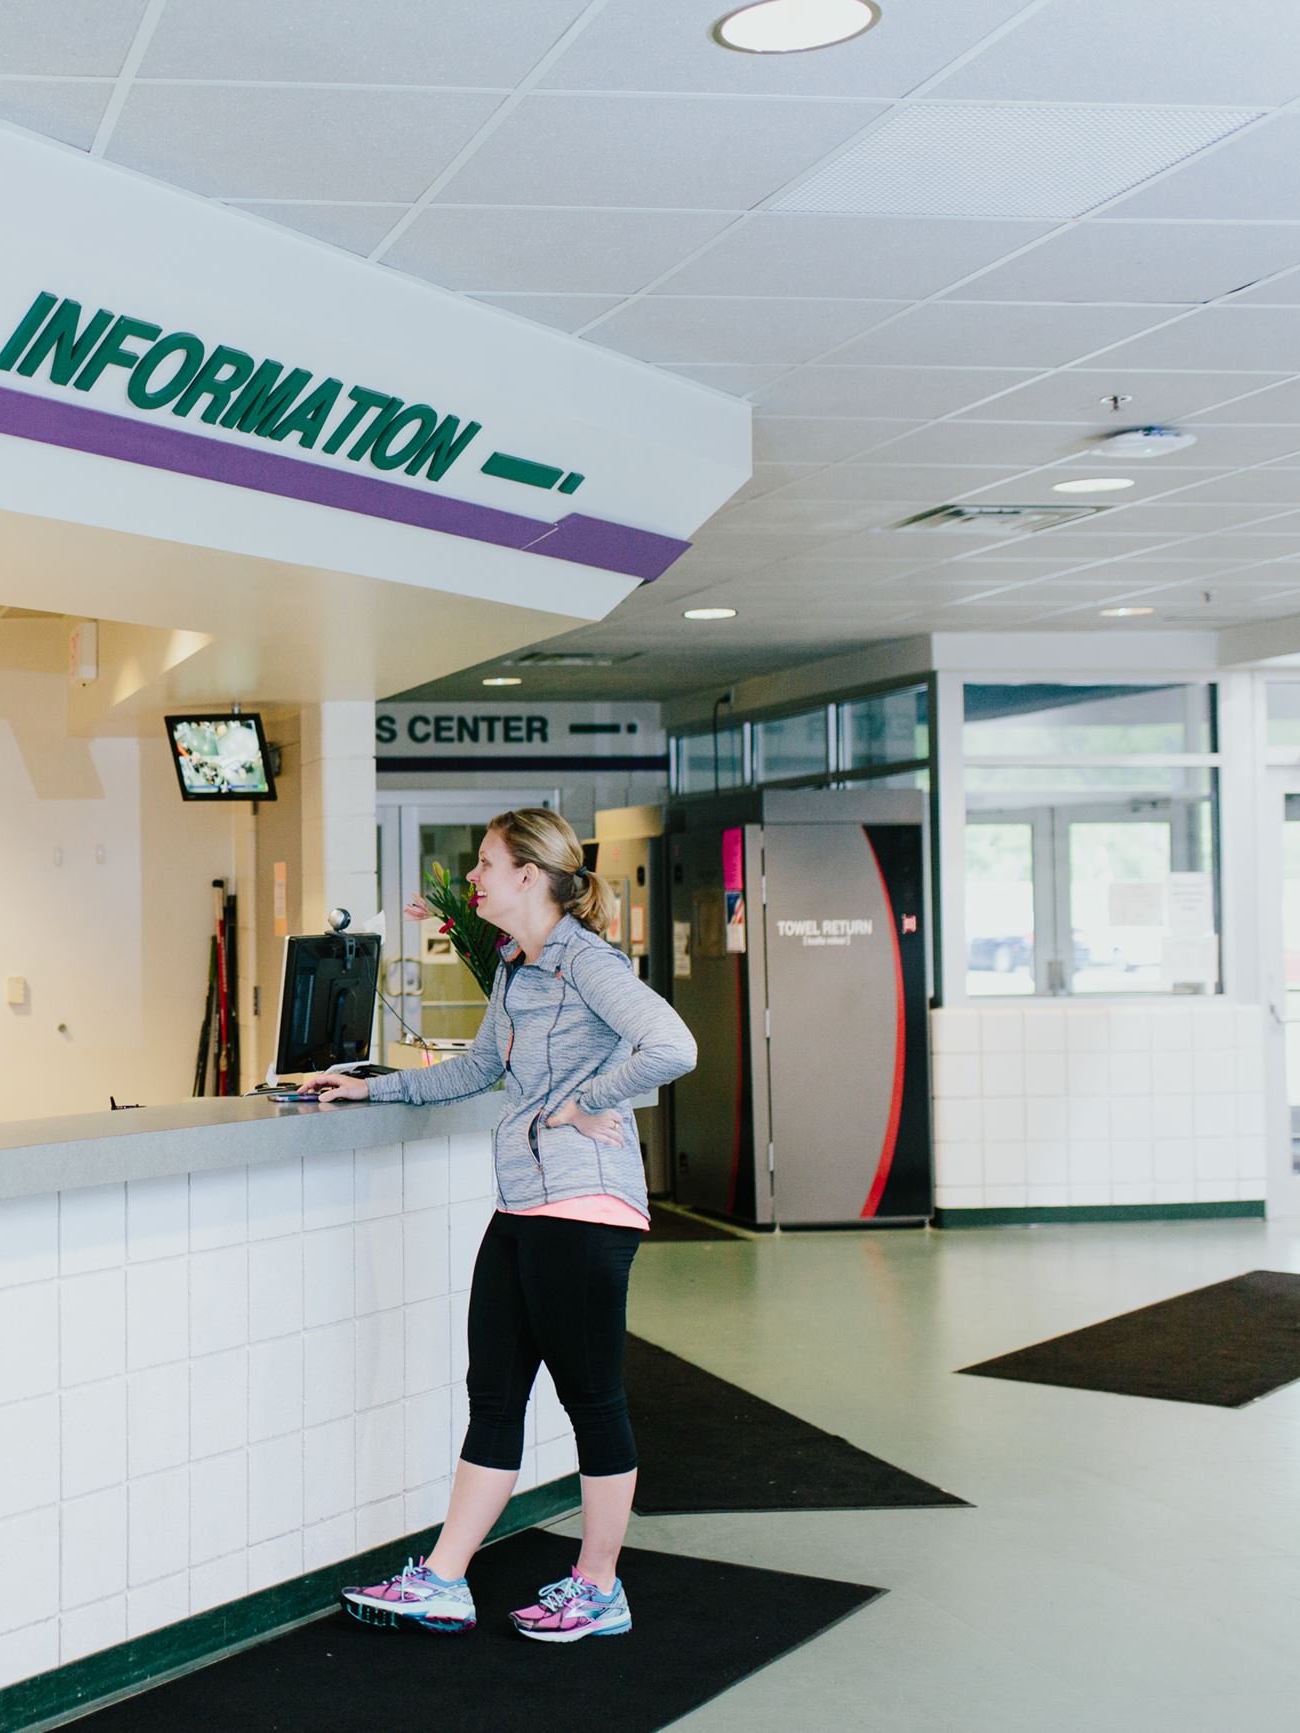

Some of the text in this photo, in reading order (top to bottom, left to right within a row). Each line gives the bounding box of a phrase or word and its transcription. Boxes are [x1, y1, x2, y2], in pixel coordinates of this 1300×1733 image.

[408, 715, 549, 744] CENTER
[777, 919, 873, 936] TOWEL RETURN
